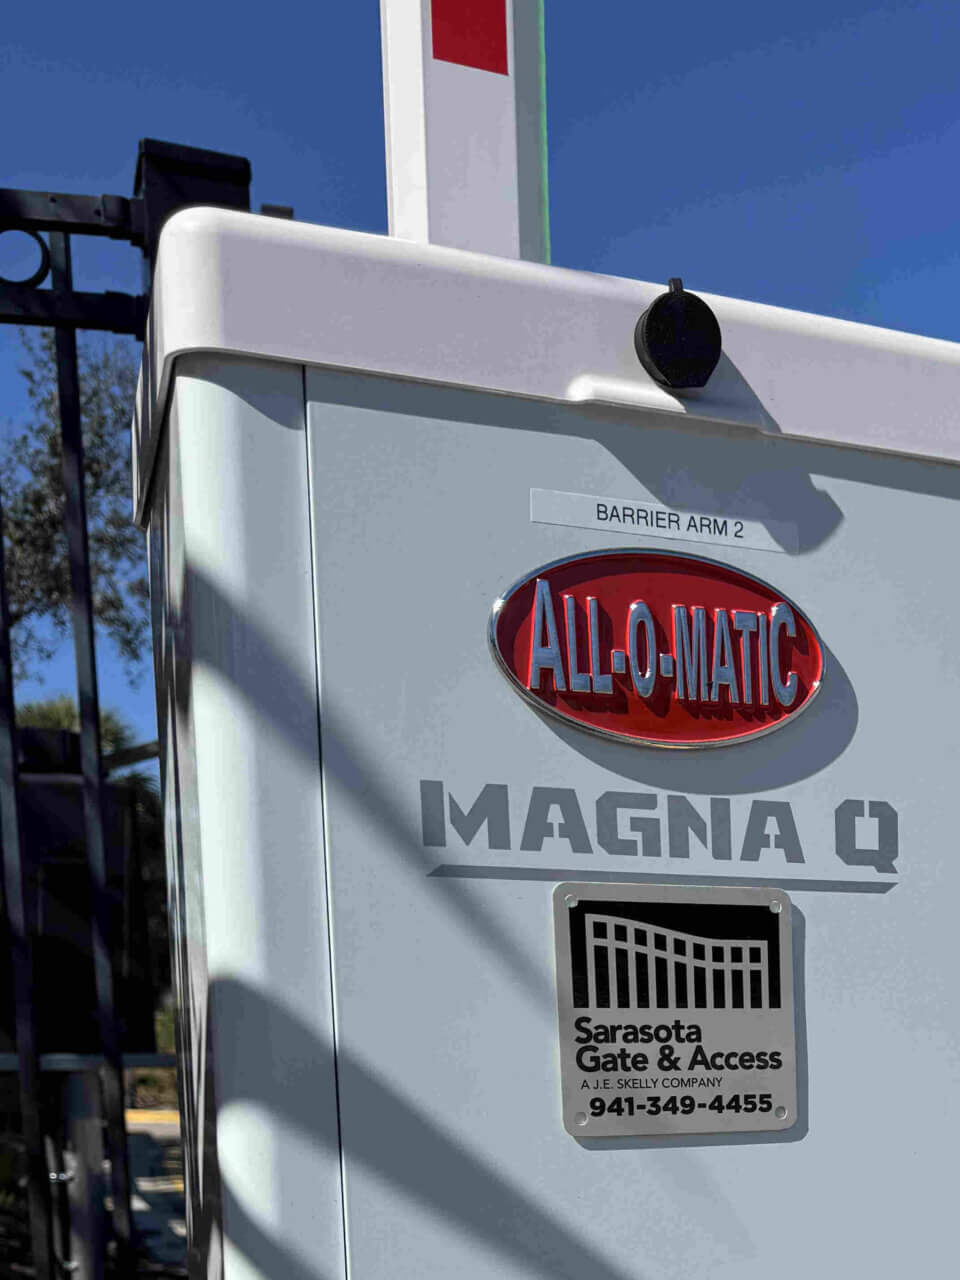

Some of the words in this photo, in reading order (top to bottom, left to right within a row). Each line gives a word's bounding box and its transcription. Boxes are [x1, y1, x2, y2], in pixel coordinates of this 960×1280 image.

[596, 503, 681, 530] BARRIER
[686, 515, 728, 537] ARM
[733, 520, 745, 539] 2
[527, 578, 798, 708] ALL-O-MATIC
[419, 779, 806, 864] MAGNA
[834, 798, 899, 874] Q
[573, 1015, 703, 1045] Sarasota
[575, 1045, 649, 1073] Gate
[656, 1044, 682, 1071] &
[687, 1044, 784, 1071] Access
[580, 1079, 590, 1090] A
[593, 1079, 614, 1090] J.E.
[616, 1078, 659, 1090] SKELLY
[661, 1076, 723, 1089] COMPANY
[588, 1093, 774, 1117] 941-349-4455
